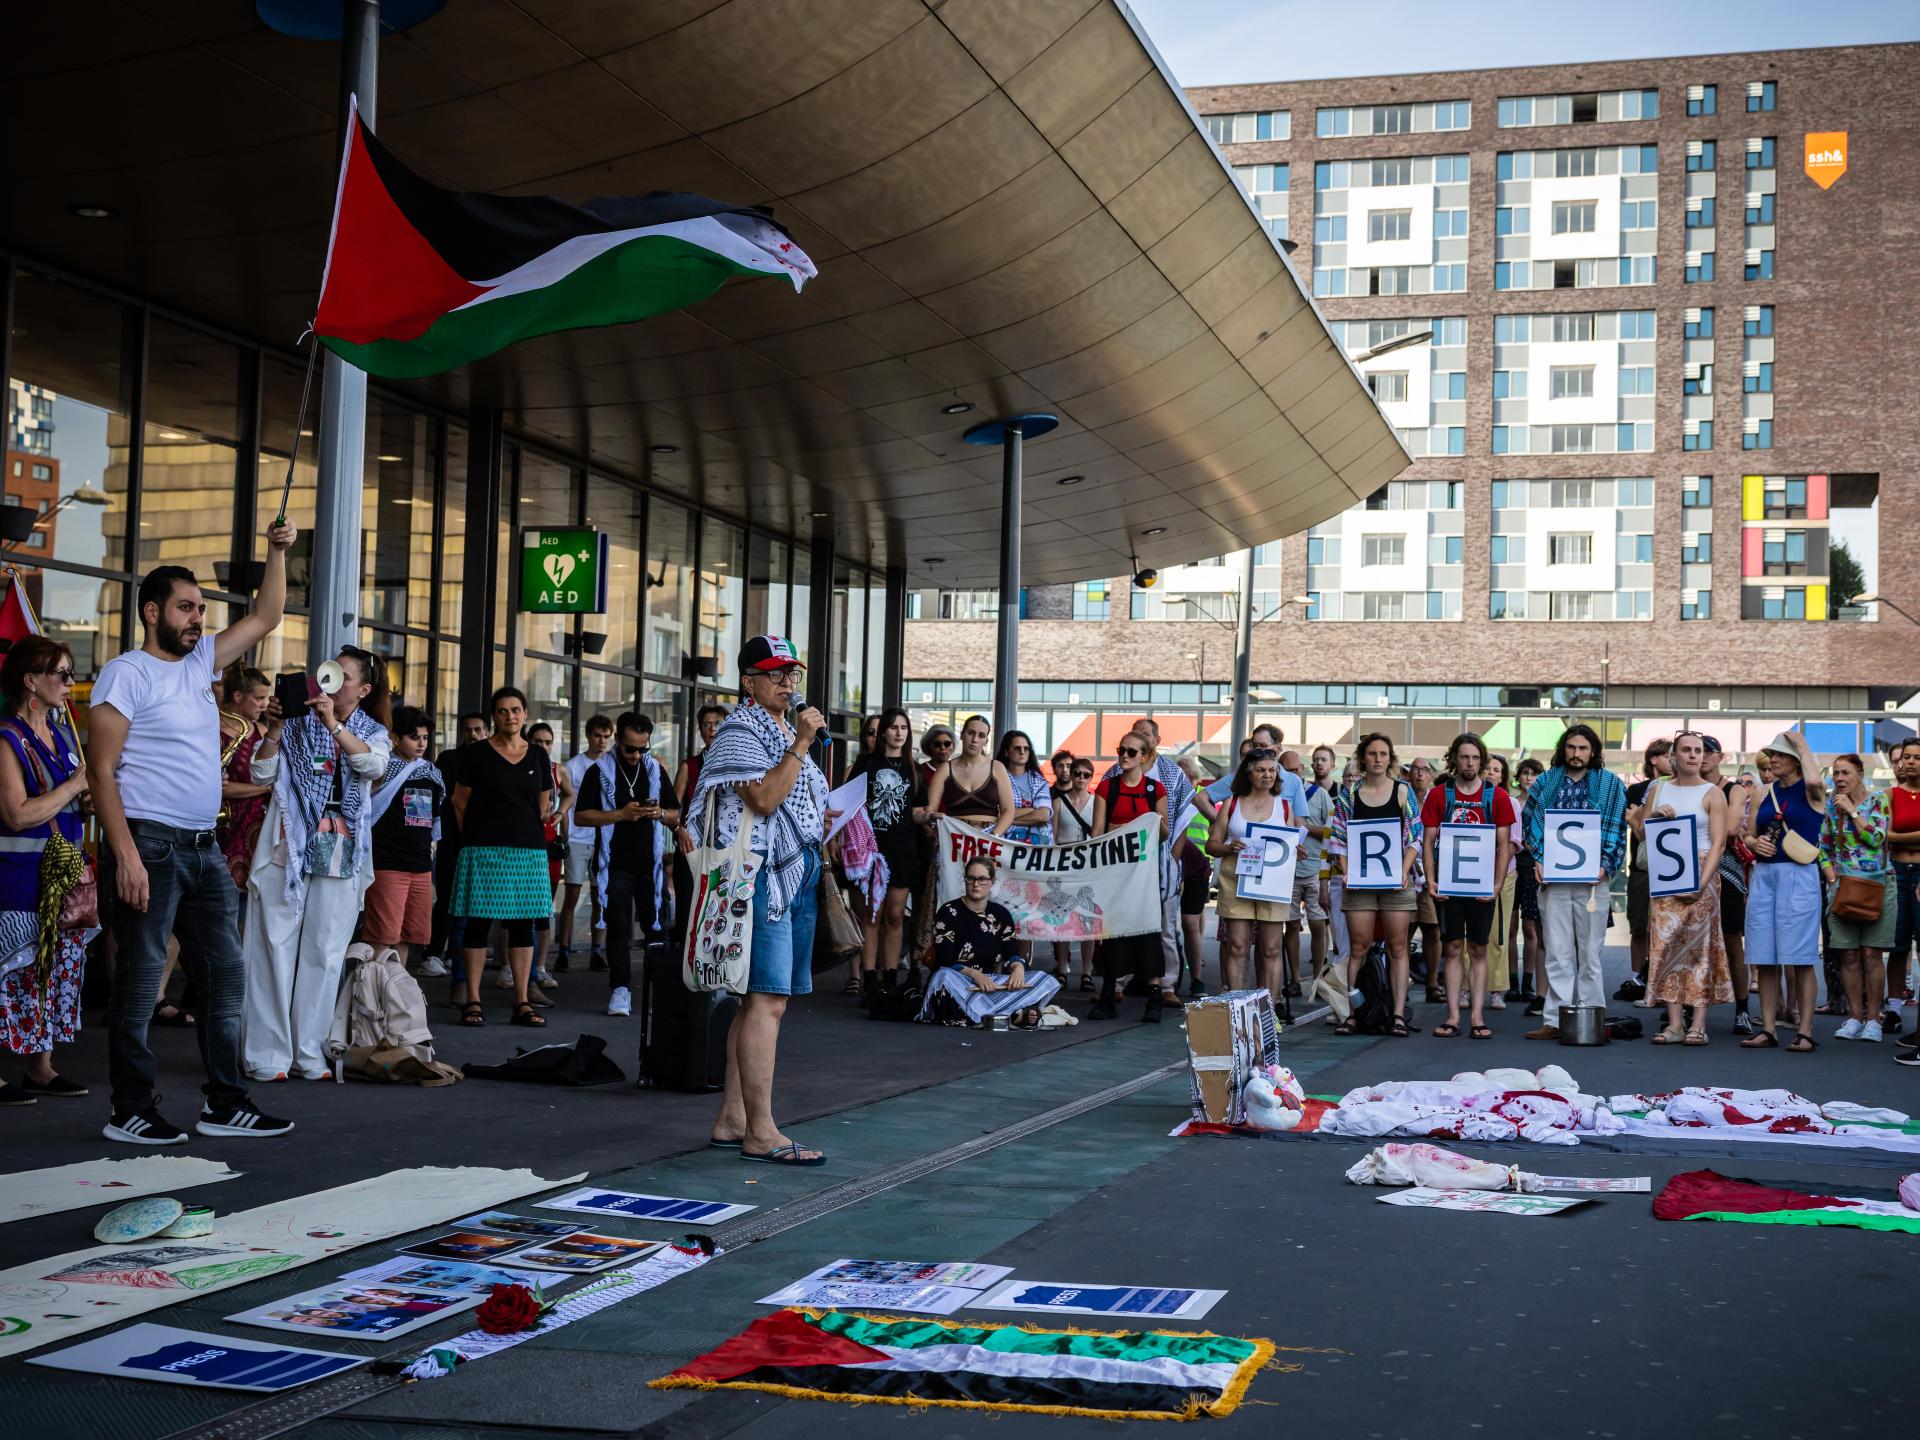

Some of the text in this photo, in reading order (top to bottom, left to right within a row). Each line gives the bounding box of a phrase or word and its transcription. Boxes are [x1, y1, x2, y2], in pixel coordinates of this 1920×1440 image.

[1808, 149, 1843, 163] ssh&
[541, 537, 559, 545] AED
[538, 590, 579, 604] AED
[1010, 828, 1148, 872] PALESTINE!
[1254, 835, 1290, 885] P
[1359, 830, 1393, 878] R
[1451, 835, 1481, 884] E
[1554, 821, 1586, 871] S
[1655, 827, 1686, 882] S
[602, 1197, 640, 1209] PRESS
[1047, 1289, 1082, 1305] PRESS
[159, 1349, 228, 1371] PRESS
